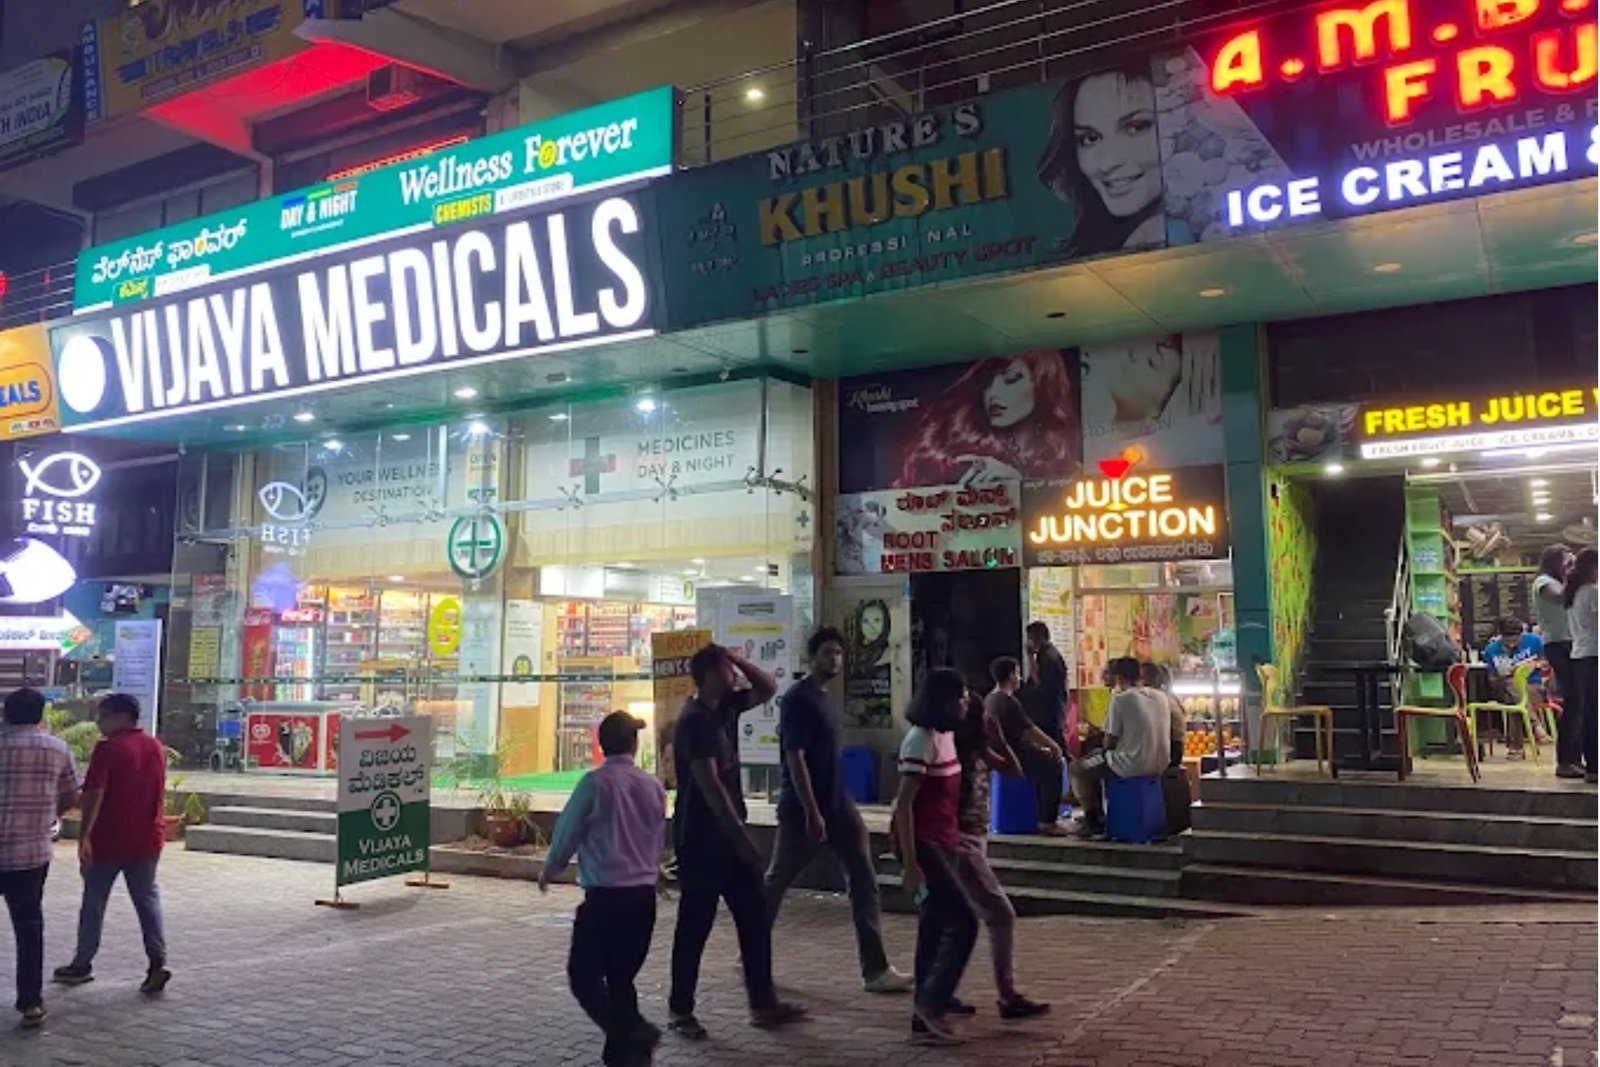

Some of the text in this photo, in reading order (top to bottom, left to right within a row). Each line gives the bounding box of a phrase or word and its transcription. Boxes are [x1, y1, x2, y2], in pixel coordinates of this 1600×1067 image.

[82, 23, 98, 120] AMBULANCE
[1383, 23, 1598, 124] FRU
[768, 104, 981, 180] NATURES
[1352, 108, 1545, 161] WHOLESALE
[1554, 103, 1575, 121] &
[399, 117, 638, 205] Wellness Forever
[1227, 176, 1322, 227] ICE
[1341, 132, 1568, 206] CREAM
[280, 203, 304, 230] DAY
[319, 190, 358, 219] NIGHT
[435, 194, 492, 224] CHEMISTS
[758, 148, 1008, 247] KHUSHI
[110, 198, 648, 413] VIJAYA MEDICALS
[1365, 402, 1472, 434] FRESH
[1480, 390, 1584, 423] JUICE
[636, 430, 735, 456] MEDICINES
[1371, 445, 1409, 455] FRESH
[1412, 440, 1447, 452] FRUIT
[1451, 437, 1485, 448] JUICE
[1499, 434, 1517, 445] ICE
[1522, 430, 1575, 443] CREAMS
[337, 463, 452, 485] YOUR WELLNE
[637, 454, 735, 478] DAY & NIGHT
[353, 485, 433, 504] DESTINATION
[1066, 474, 1174, 509] JUICE
[22, 498, 96, 525] FISH
[1029, 506, 1215, 544] JUNCTION
[883, 531, 938, 549] ROOT
[881, 547, 1015, 573] MENS SALON
[667, 633, 700, 651] ROOT
[358, 834, 411, 854] VIJAYA
[343, 849, 425, 878] MEDICALS
